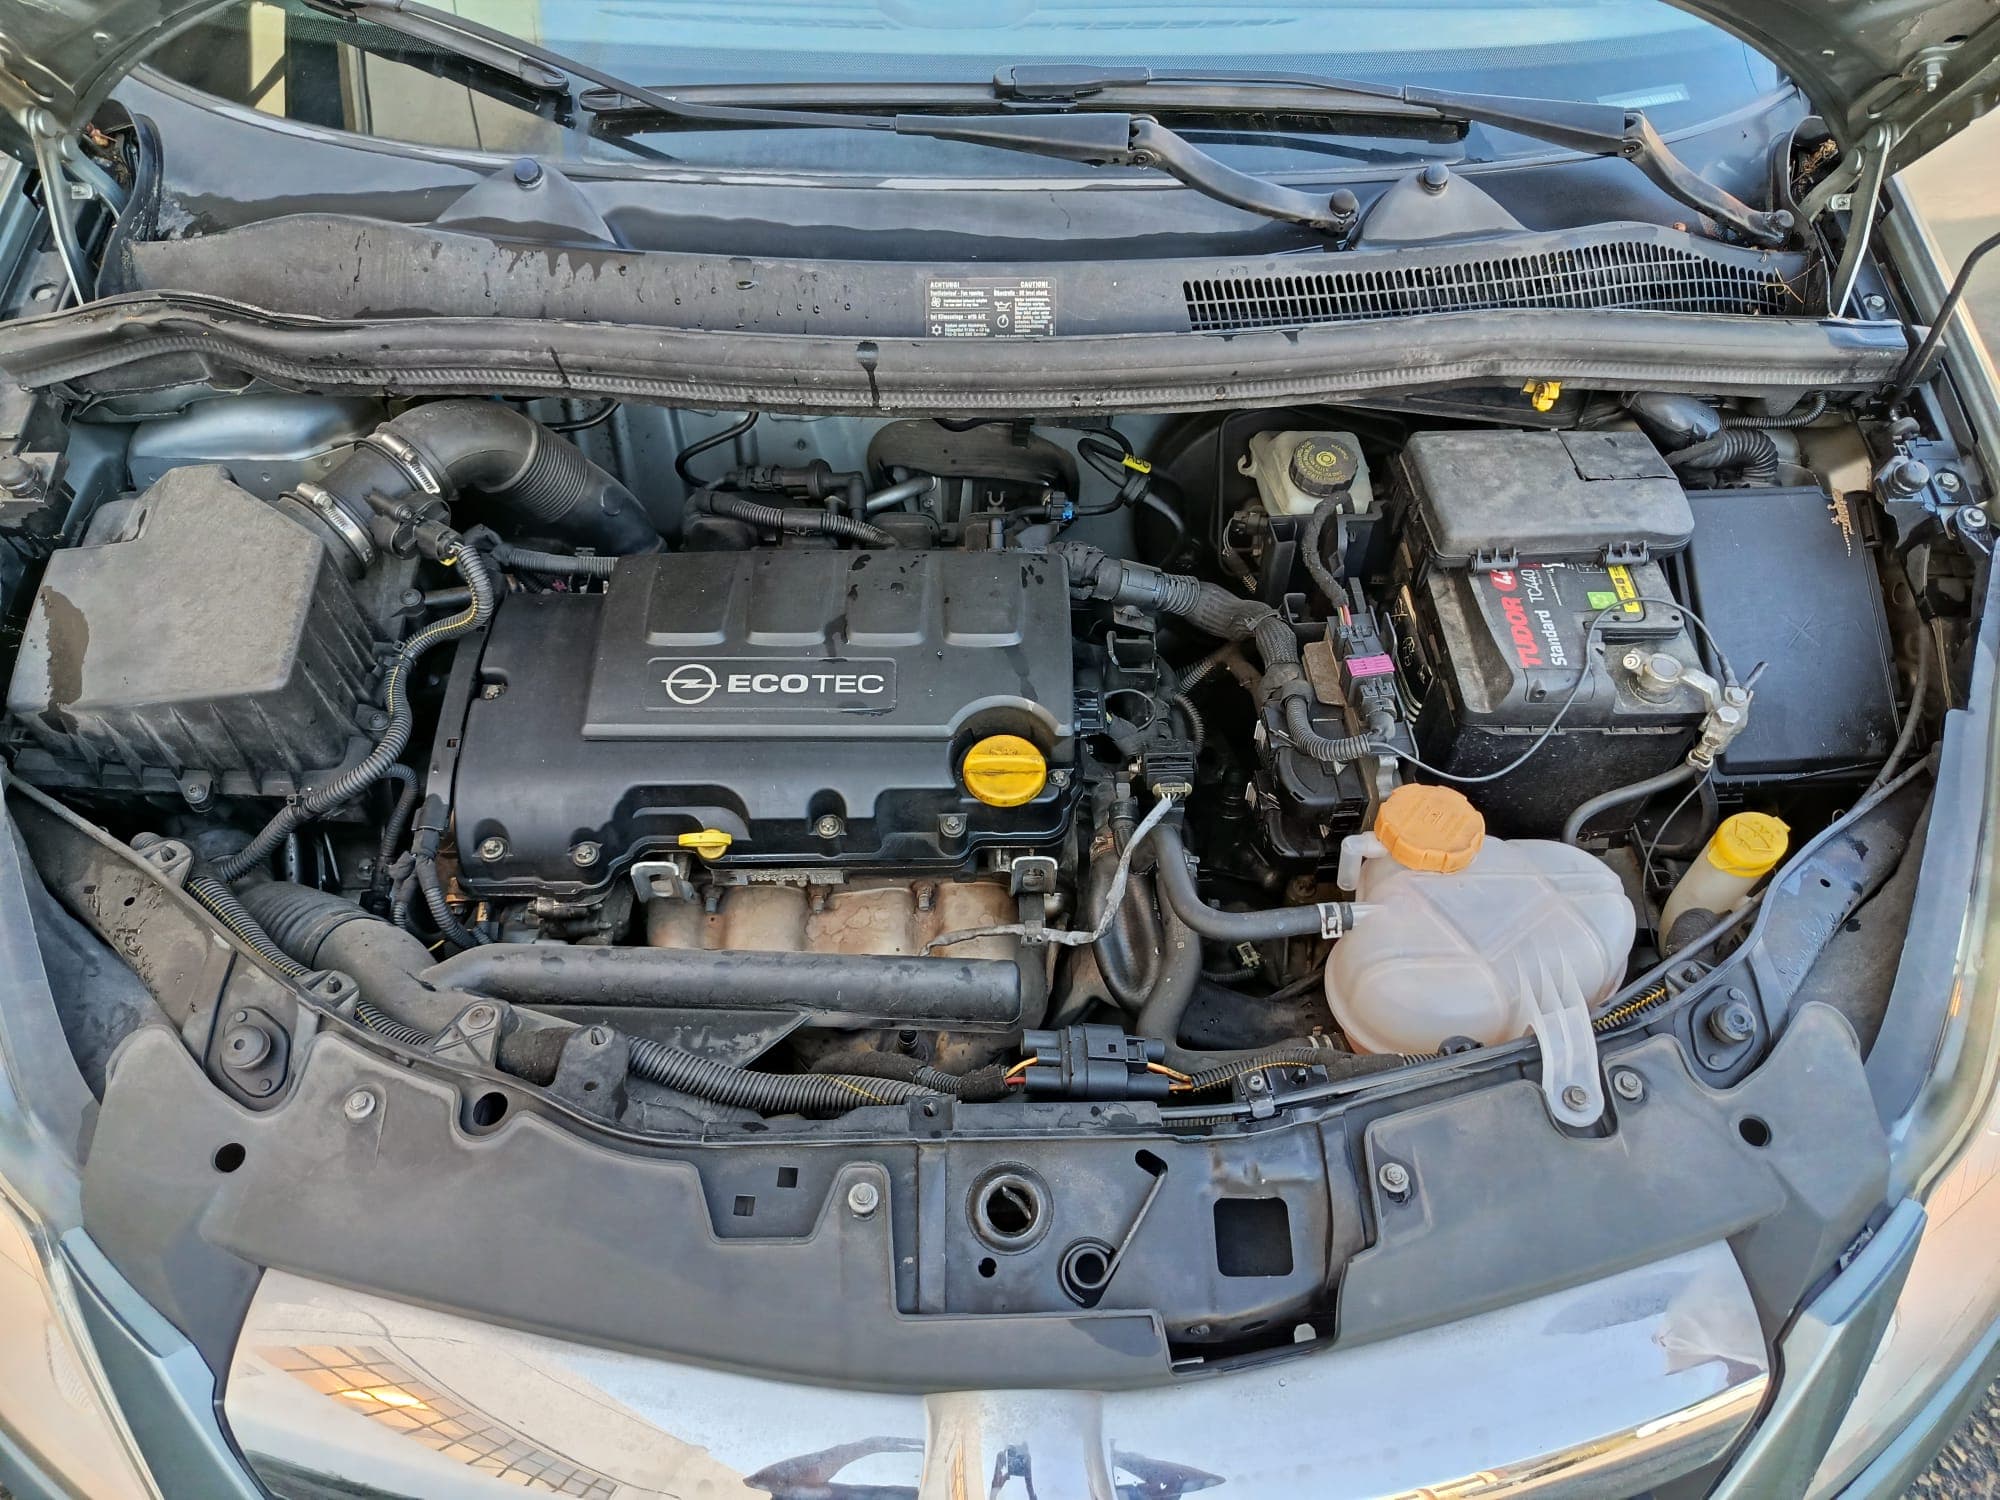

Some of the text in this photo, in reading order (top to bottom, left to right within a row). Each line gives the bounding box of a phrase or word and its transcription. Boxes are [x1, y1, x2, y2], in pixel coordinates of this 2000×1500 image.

[1020, 281, 1049, 289] CAUTION!
[1520, 569, 1545, 603] TC440
[1501, 596, 1543, 668] TUDOR
[1534, 610, 1568, 667] Standard
[727, 674, 885, 694] ECOTEC
